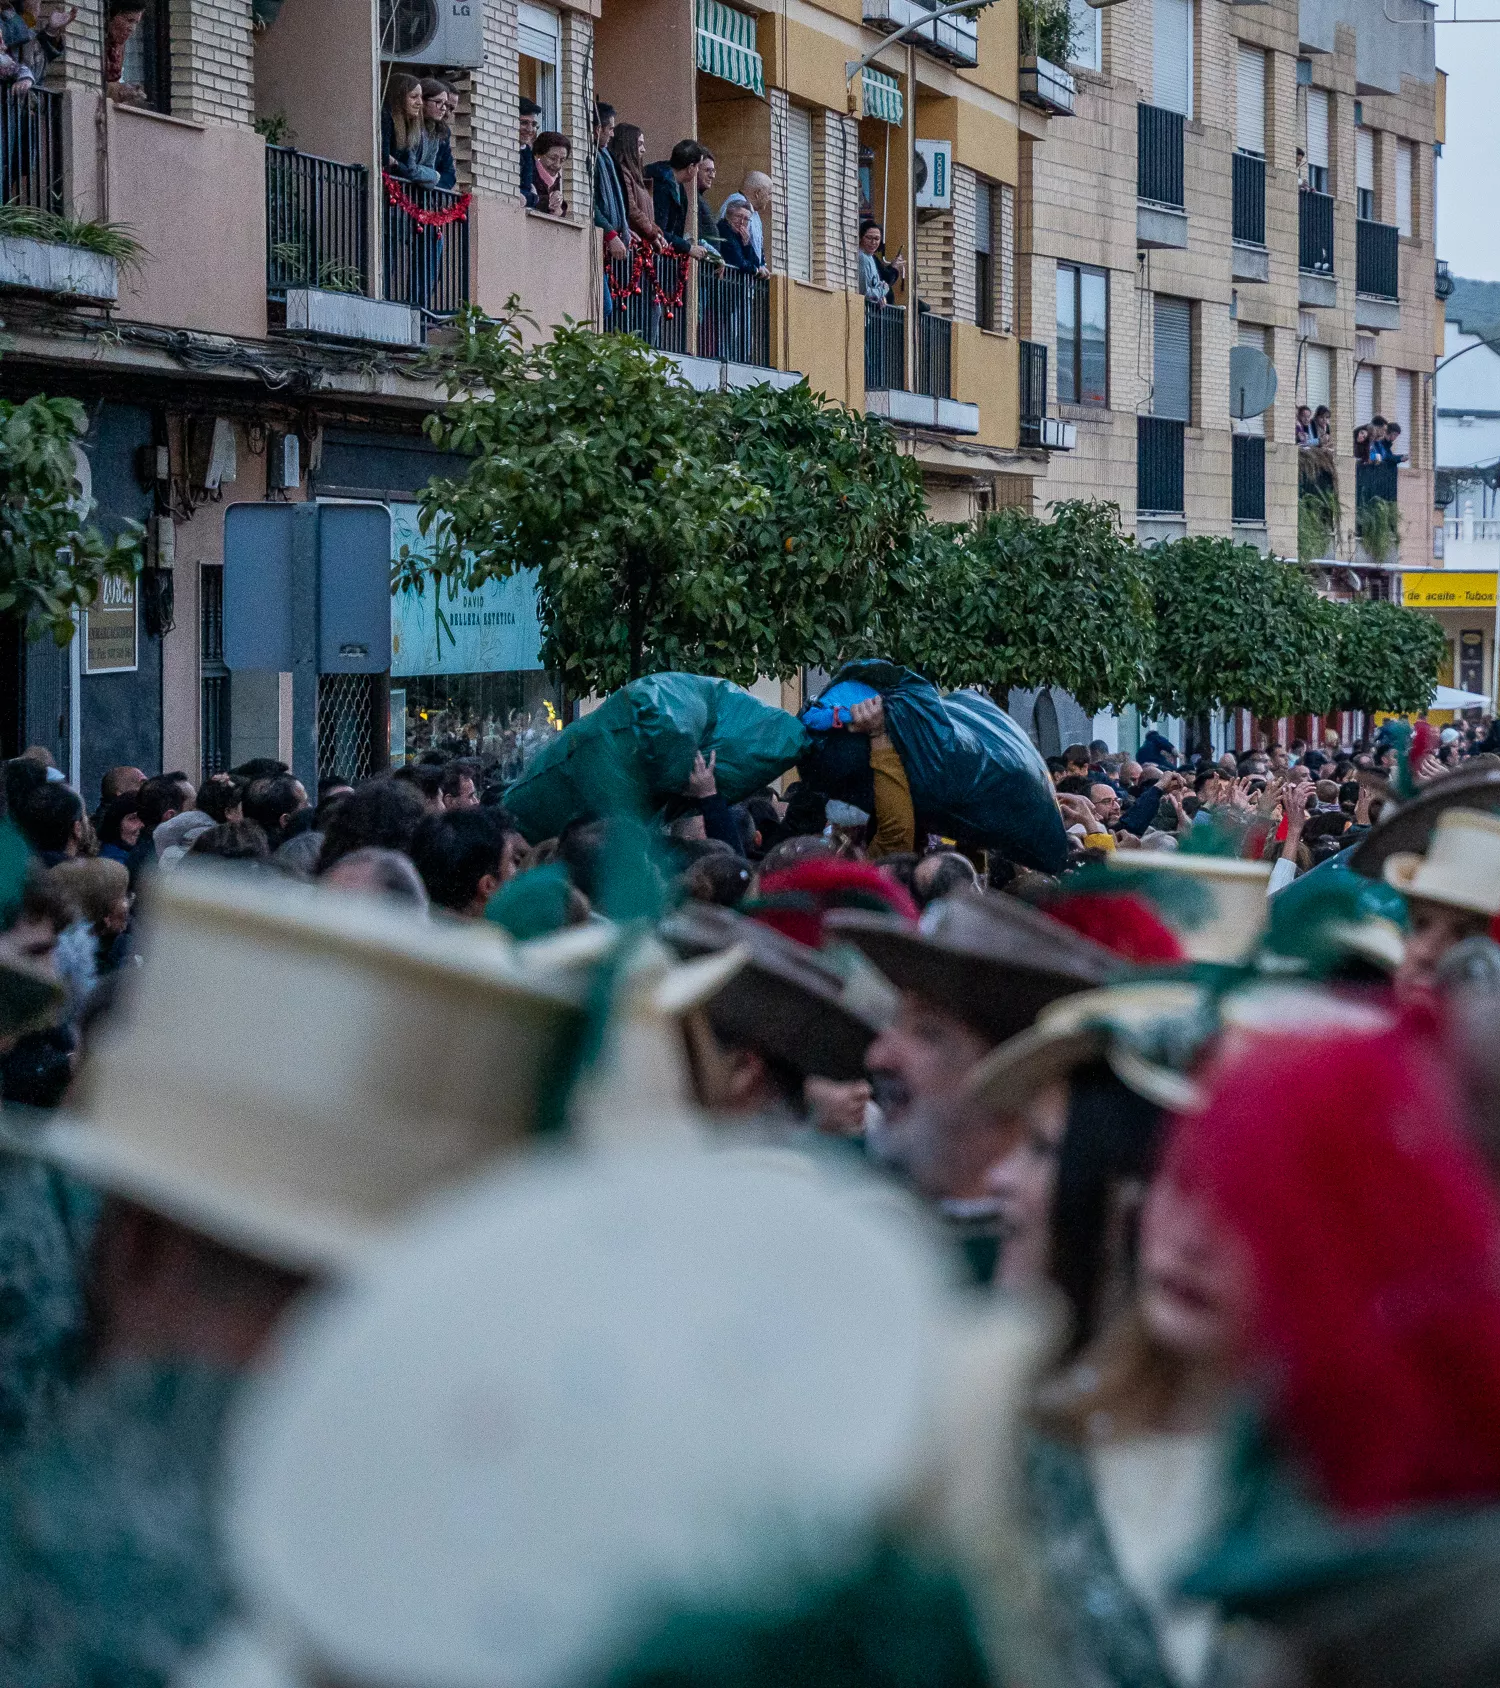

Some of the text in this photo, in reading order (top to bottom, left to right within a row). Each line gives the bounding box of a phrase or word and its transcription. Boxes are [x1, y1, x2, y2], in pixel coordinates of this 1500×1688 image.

[453, 5, 470, 16] LG
[1407, 591, 1420, 600] de
[1425, 591, 1455, 601] aceite
[1465, 591, 1493, 601] Tubos
[463, 596, 484, 608] DAVID
[450, 612, 516, 626] BELLEZA ESTETICA
